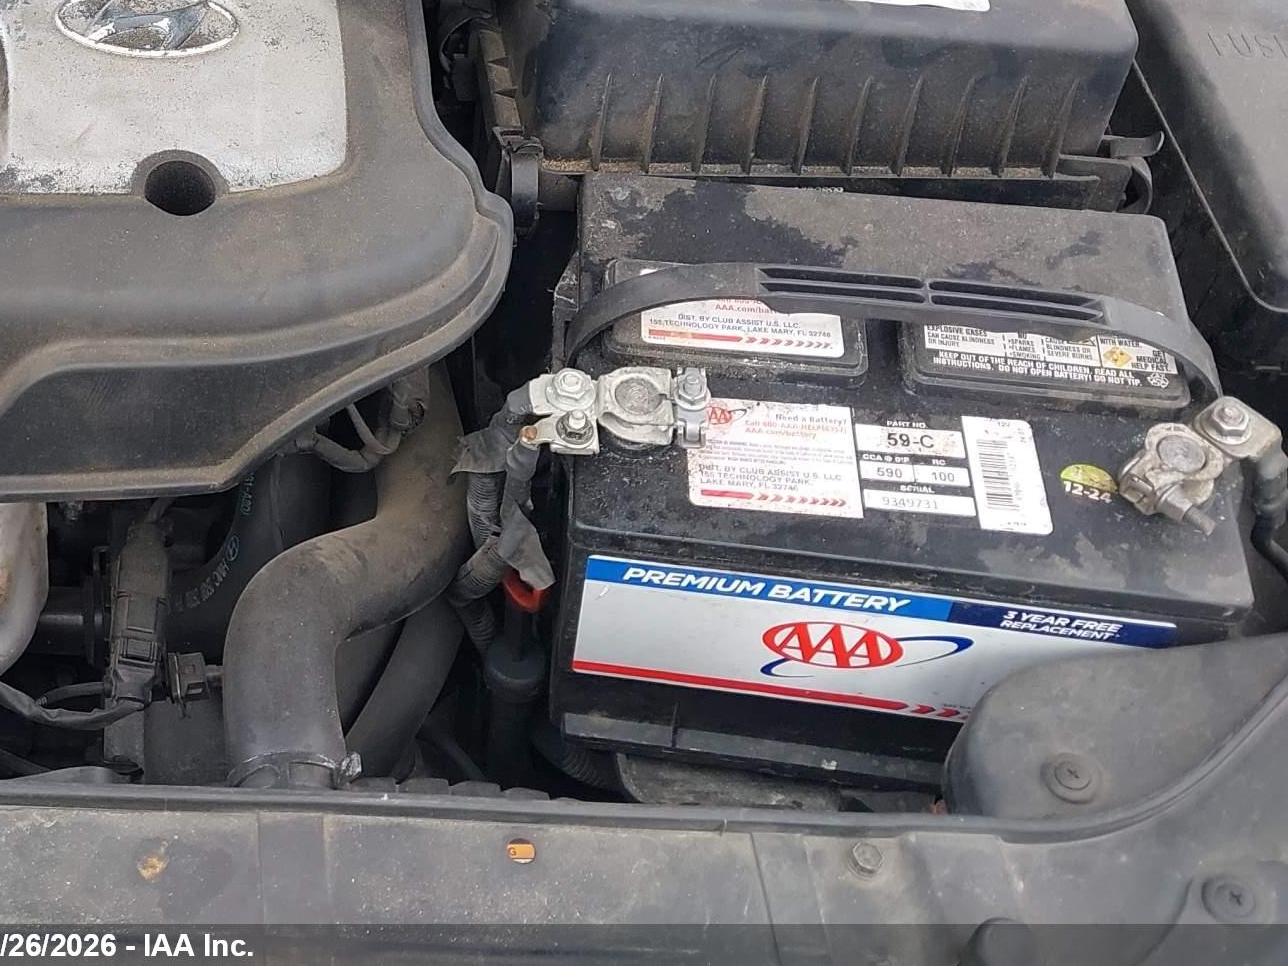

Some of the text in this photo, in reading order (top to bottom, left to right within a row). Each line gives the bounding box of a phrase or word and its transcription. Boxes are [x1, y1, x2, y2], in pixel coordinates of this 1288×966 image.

[664, 320, 719, 328] TECHNOLOGY
[934, 357, 994, 371] INSTRUCTIONS.
[1012, 366, 1029, 374] NOT
[1030, 368, 1053, 376] OPEN
[1094, 374, 1106, 382] DO
[1108, 376, 1125, 384] NOT
[1127, 378, 1142, 387] TIP.
[939, 351, 958, 360] KEEP
[960, 353, 976, 361] OUT
[990, 356, 1006, 365] THE
[1007, 359, 1034, 367] REACH
[1094, 368, 1117, 377] READ
[1118, 371, 1134, 379] ALL
[886, 420, 910, 428] PART
[887, 433, 934, 449] 59-C
[717, 472, 782, 483] TECHNOLOGY
[739, 467, 764, 475] CLUB
[768, 469, 801, 477] ASSIST
[876, 467, 902, 478] 590
[932, 472, 954, 482] 100
[1063, 480, 1112, 504] 12-24
[881, 496, 939, 510] 9349731
[623, 567, 911, 612] PREMIUM BATTERY
[1003, 611, 1123, 633] 3 YEAR FREE
[775, 622, 884, 667] AAA
